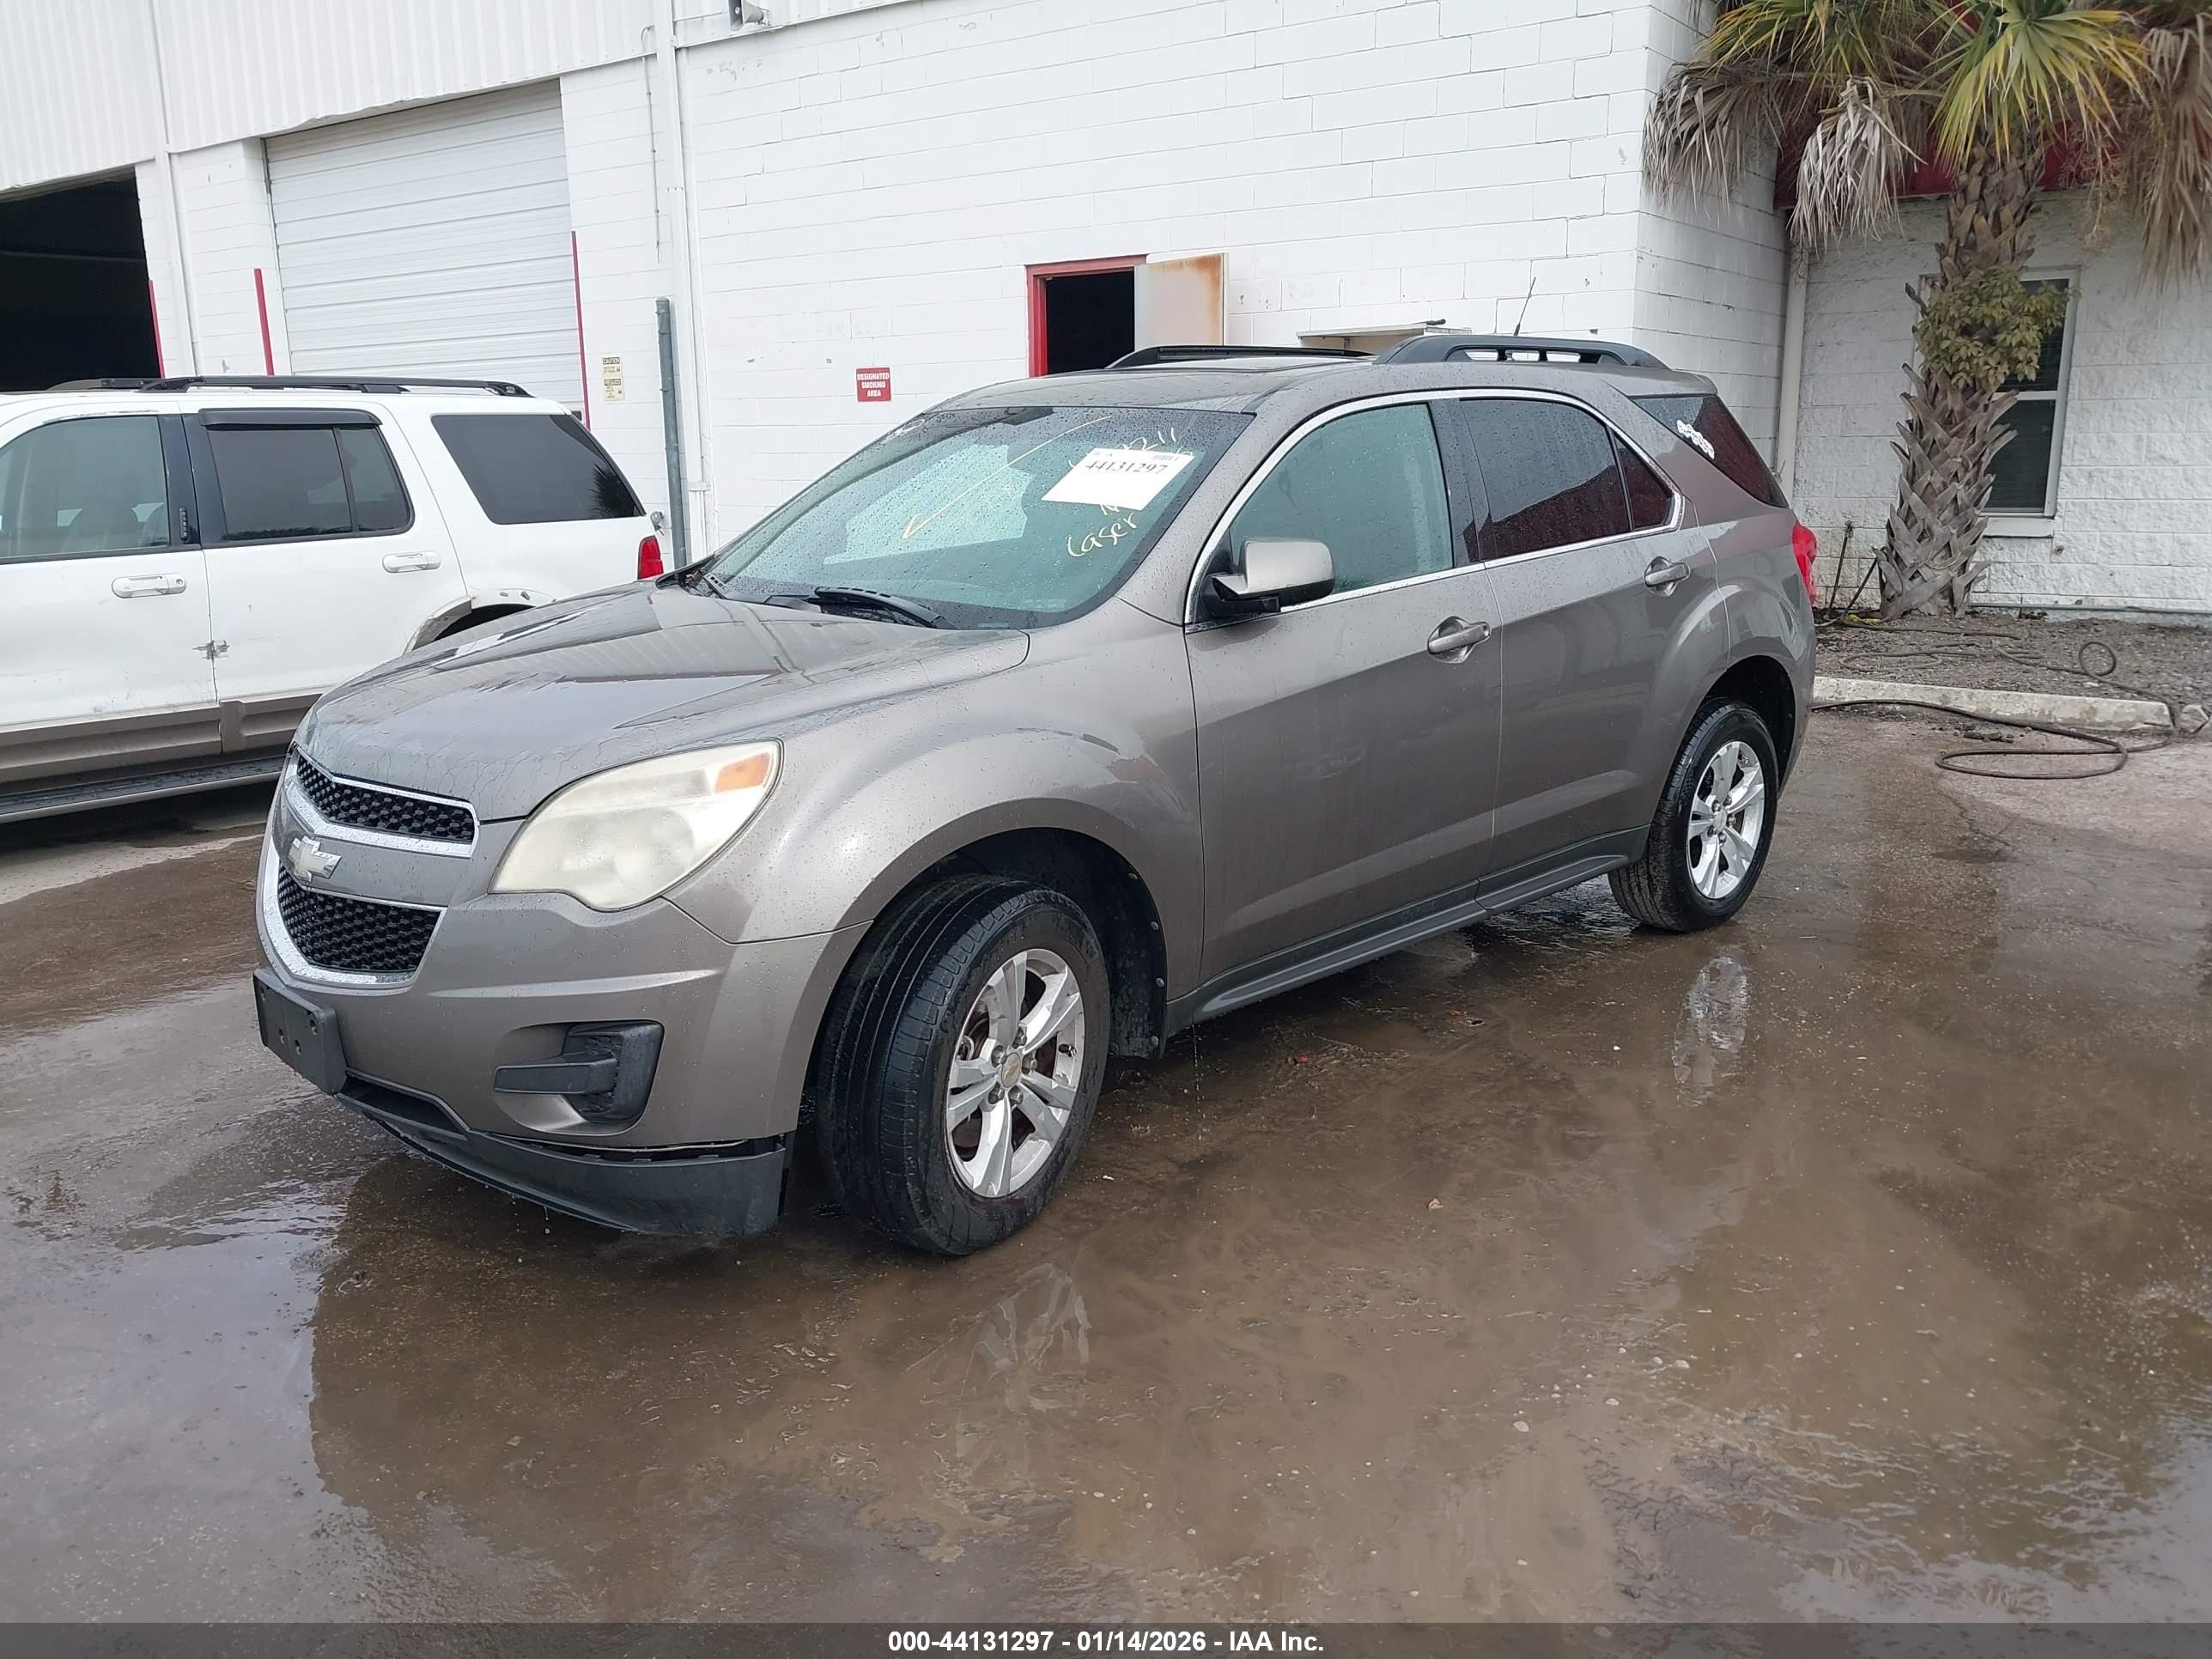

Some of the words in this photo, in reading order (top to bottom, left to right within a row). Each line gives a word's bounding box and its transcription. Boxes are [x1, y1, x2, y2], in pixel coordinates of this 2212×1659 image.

[857, 372, 890, 380] DESIGNATED
[861, 380, 886, 389] SMOKING
[866, 389, 882, 398] AREA
[1084, 459, 1169, 474] 44131297
